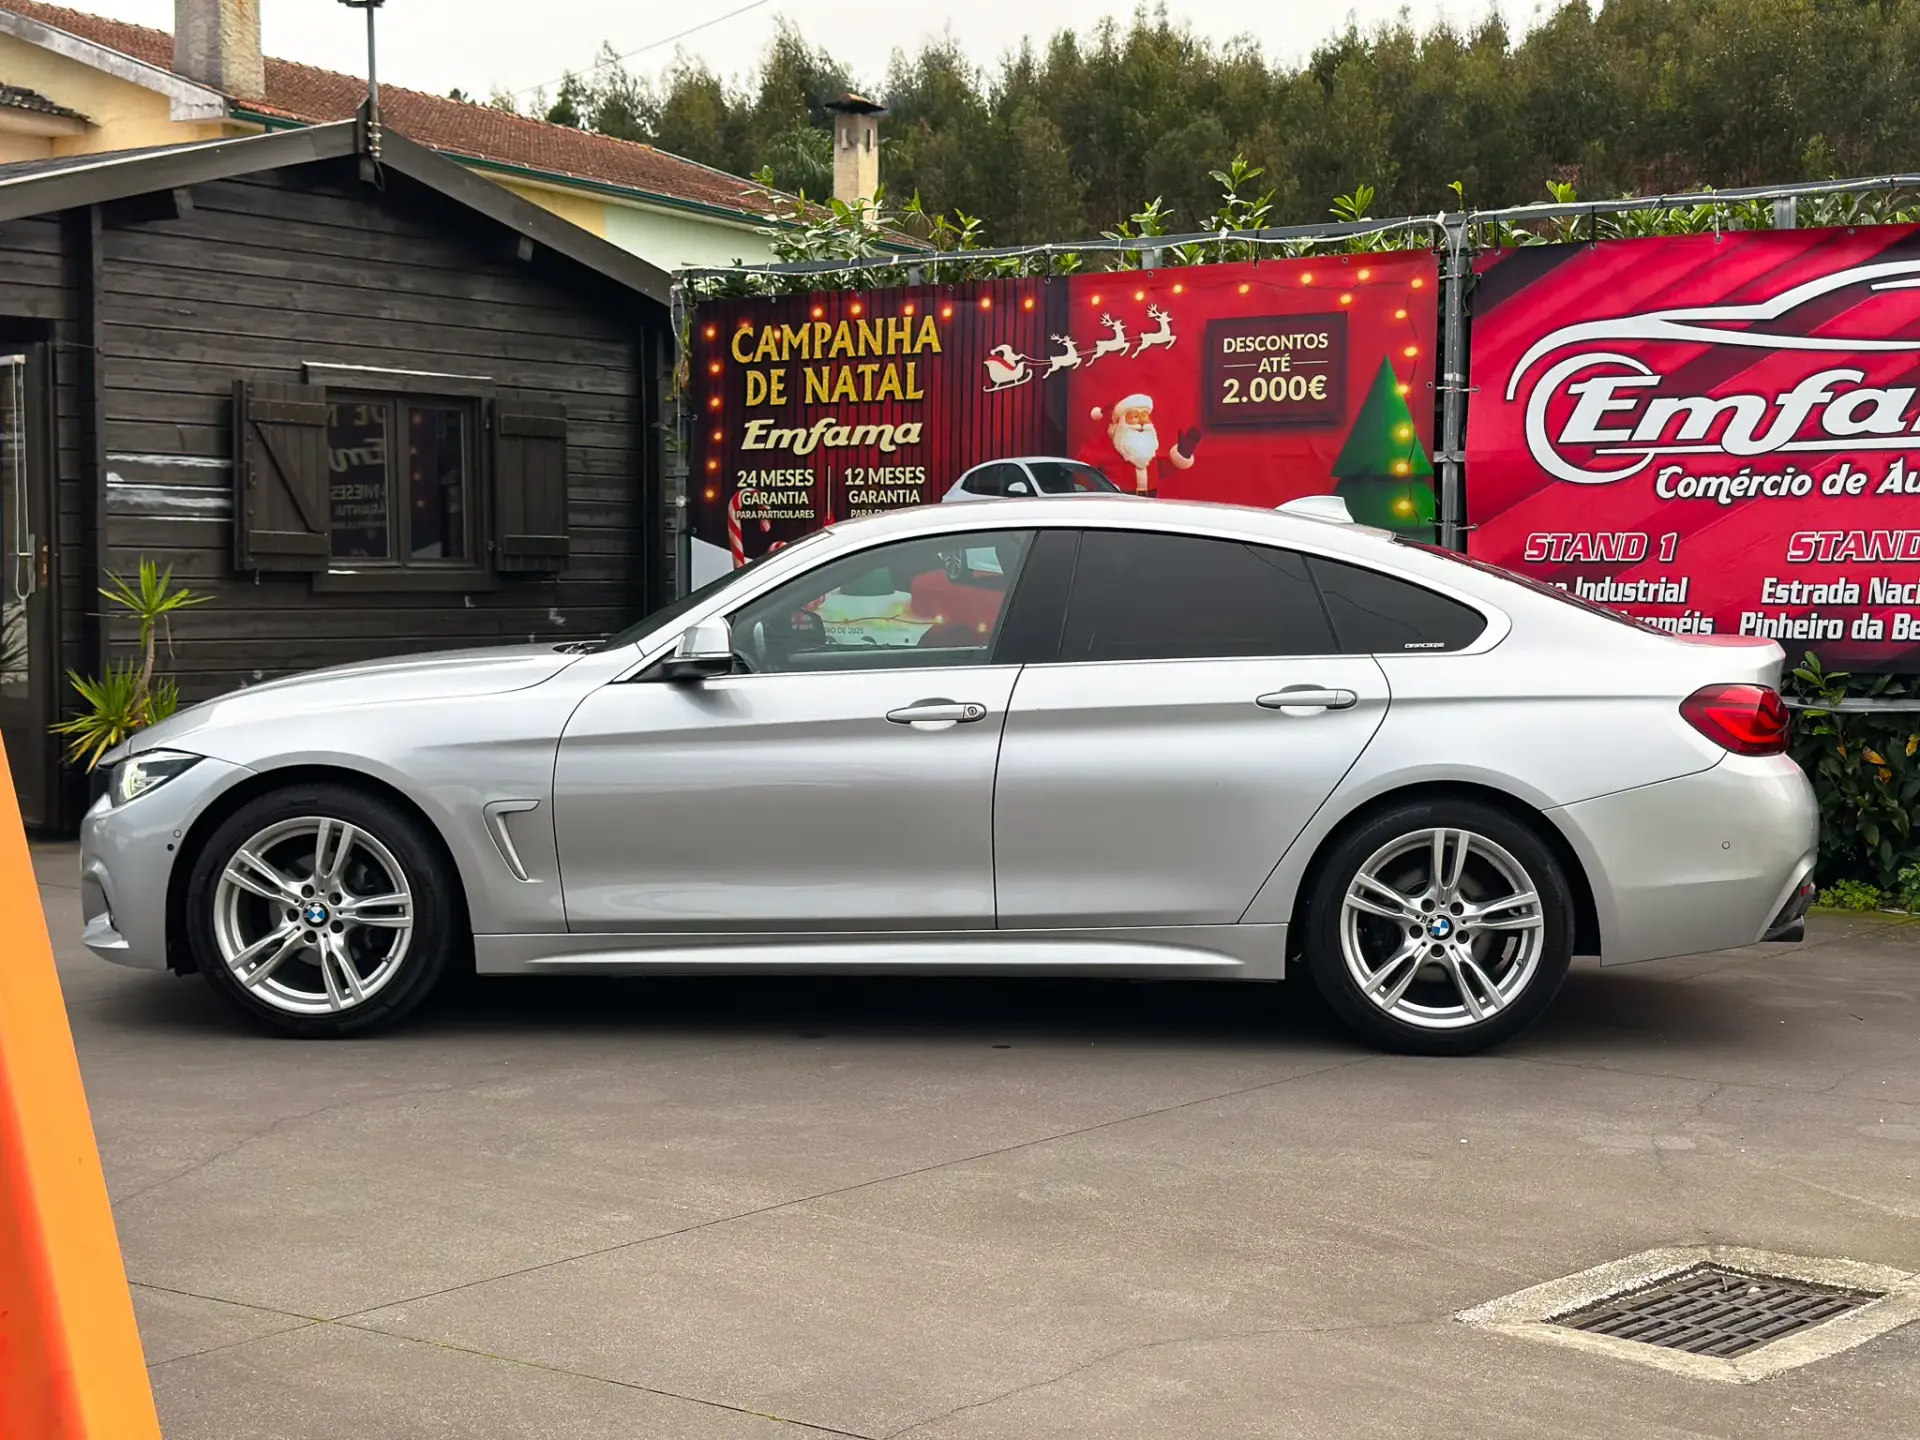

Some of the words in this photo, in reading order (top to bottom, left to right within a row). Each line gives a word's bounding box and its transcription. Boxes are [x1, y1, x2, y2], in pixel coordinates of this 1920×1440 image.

[731, 315, 942, 363] CAMPANHA
[1223, 333, 1328, 353] DESCONTOS
[1258, 353, 1290, 373] ATÉ
[746, 368, 787, 406] DE
[803, 362, 924, 403] NATAL
[1222, 375, 1327, 404] 2.000€
[1558, 369, 1920, 456] Emfa
[741, 418, 923, 455] Emfama
[737, 470, 757, 487] 24
[761, 469, 814, 487] MESES
[845, 468, 864, 485] 12
[868, 467, 925, 485] MESES
[1656, 465, 1812, 505] Comércio
[1822, 463, 1867, 495] de
[742, 492, 808, 504] GARANTIA
[849, 490, 920, 503] GARANTIA
[736, 511, 757, 519] PARA
[758, 510, 815, 519] PARTICULARES
[1524, 532, 1648, 561] STAND
[1659, 532, 1677, 561] 1
[1575, 576, 1688, 603] Industrial
[1761, 577, 1860, 604] Estrada
[1739, 612, 1844, 639] Pinheiro
[1851, 613, 1883, 640] da
